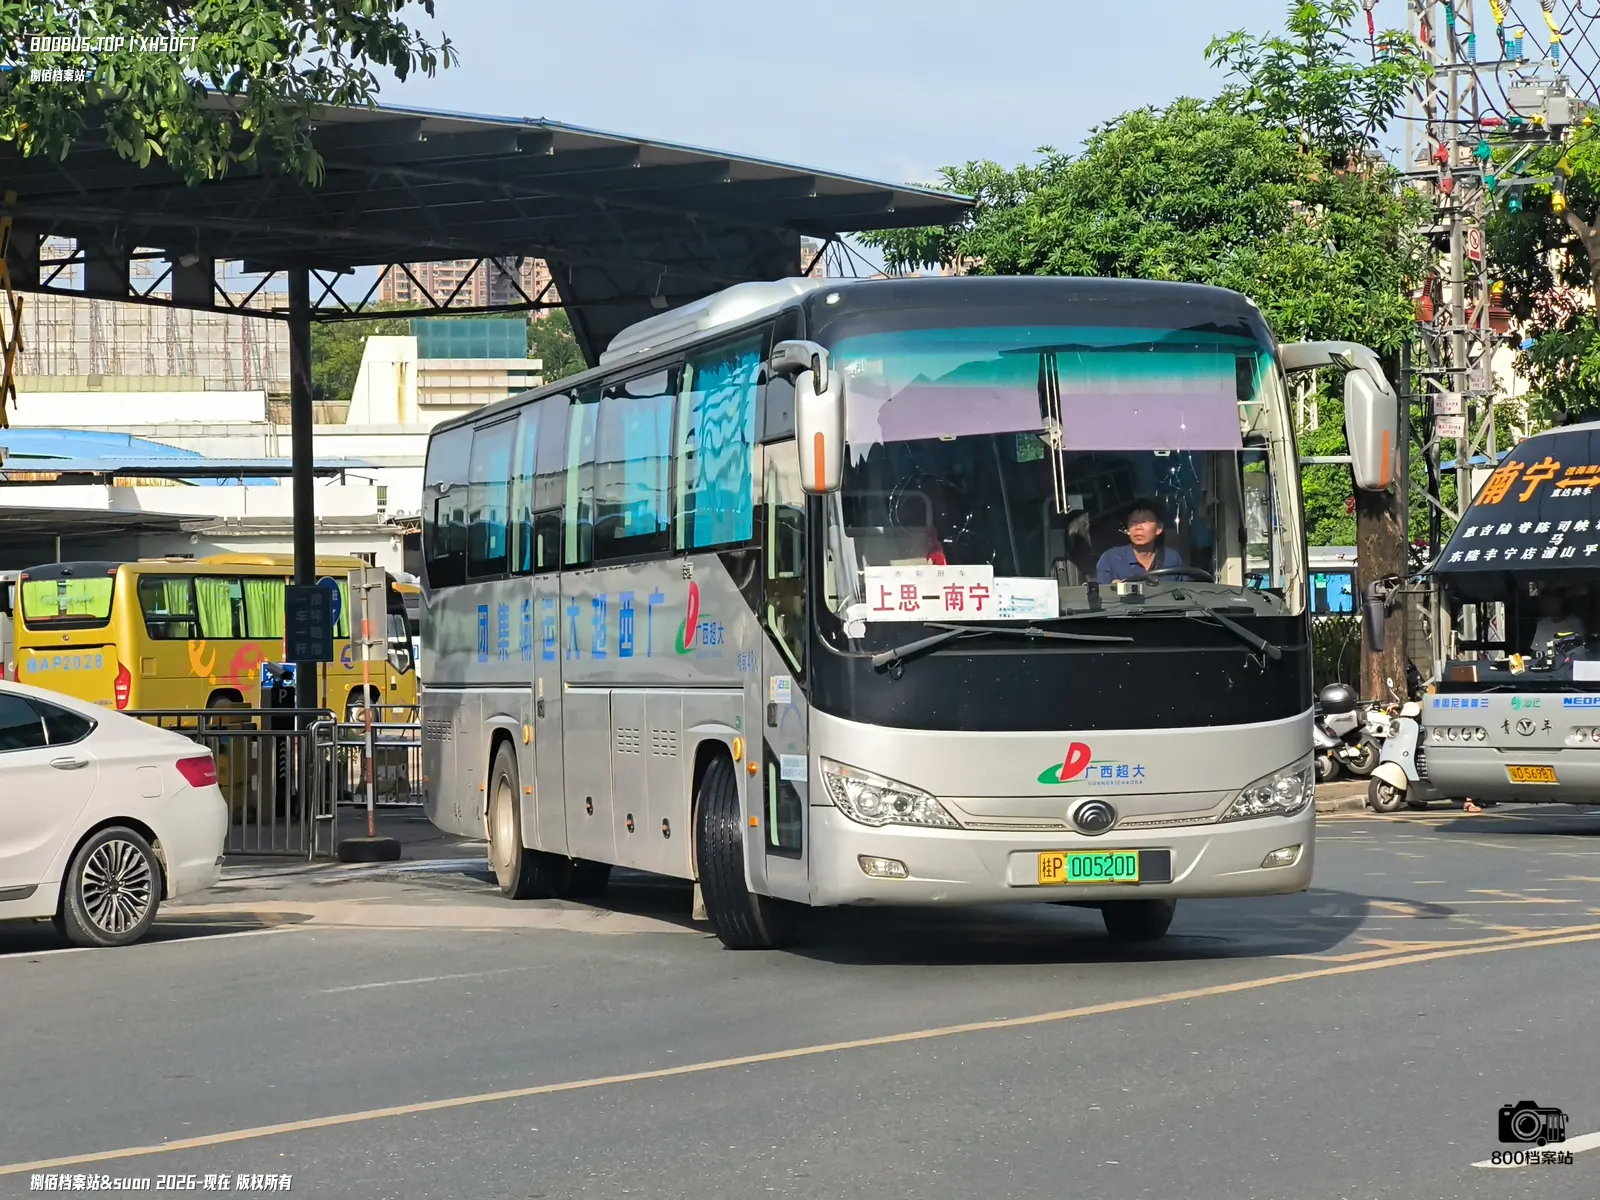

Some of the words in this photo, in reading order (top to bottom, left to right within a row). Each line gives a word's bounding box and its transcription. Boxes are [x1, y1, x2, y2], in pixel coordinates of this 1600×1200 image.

[1474, 456, 1561, 506] 南宁
[696, 622, 724, 646] 广西超大
[1085, 764, 1145, 779] 广西超大
